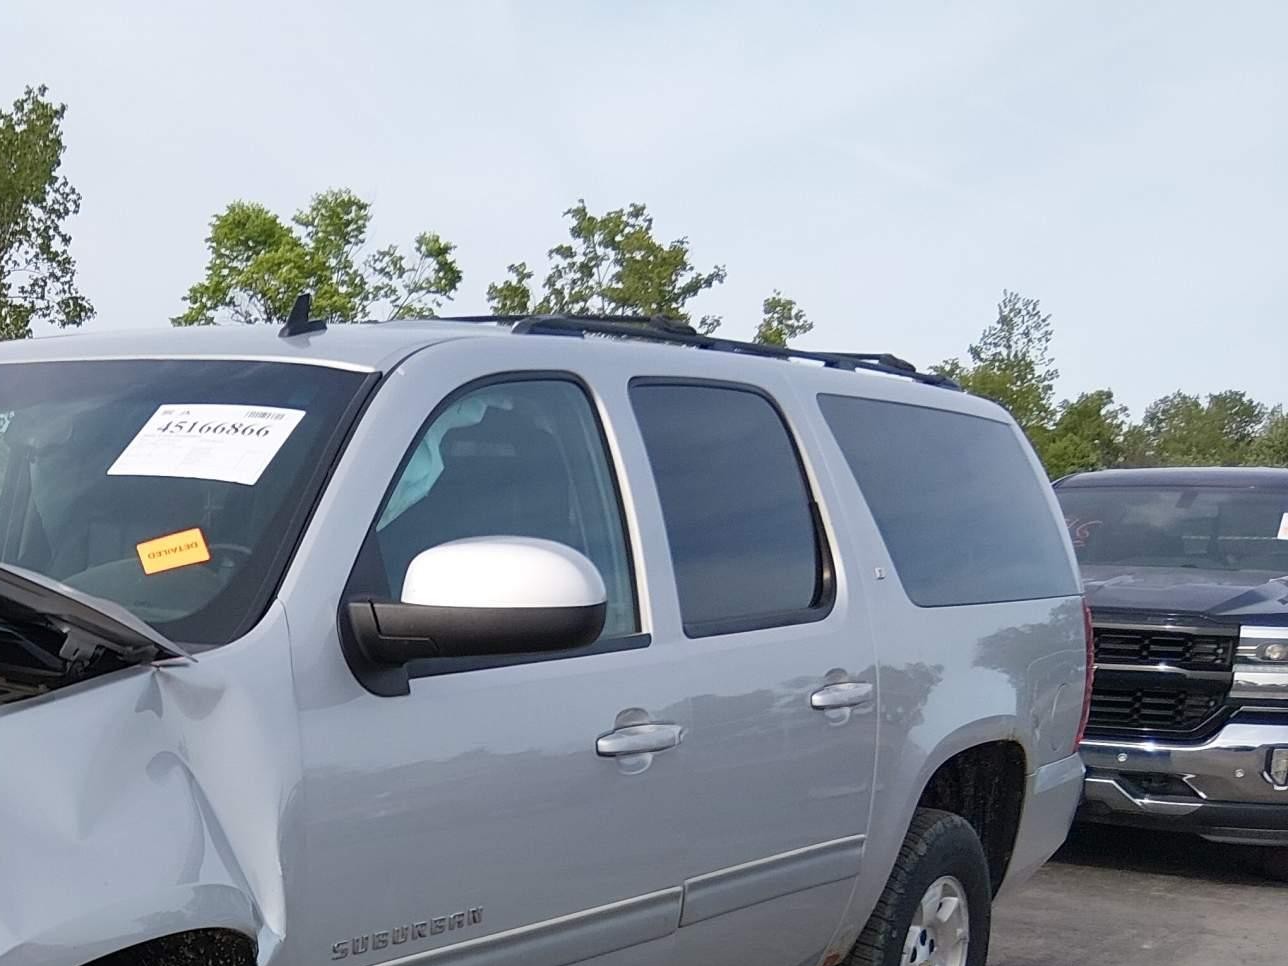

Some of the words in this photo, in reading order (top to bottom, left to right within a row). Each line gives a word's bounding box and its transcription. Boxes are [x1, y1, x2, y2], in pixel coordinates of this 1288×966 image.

[157, 420, 270, 438] 45166866
[147, 541, 199, 560] DETAILED
[331, 906, 484, 961] SUBURBAN
